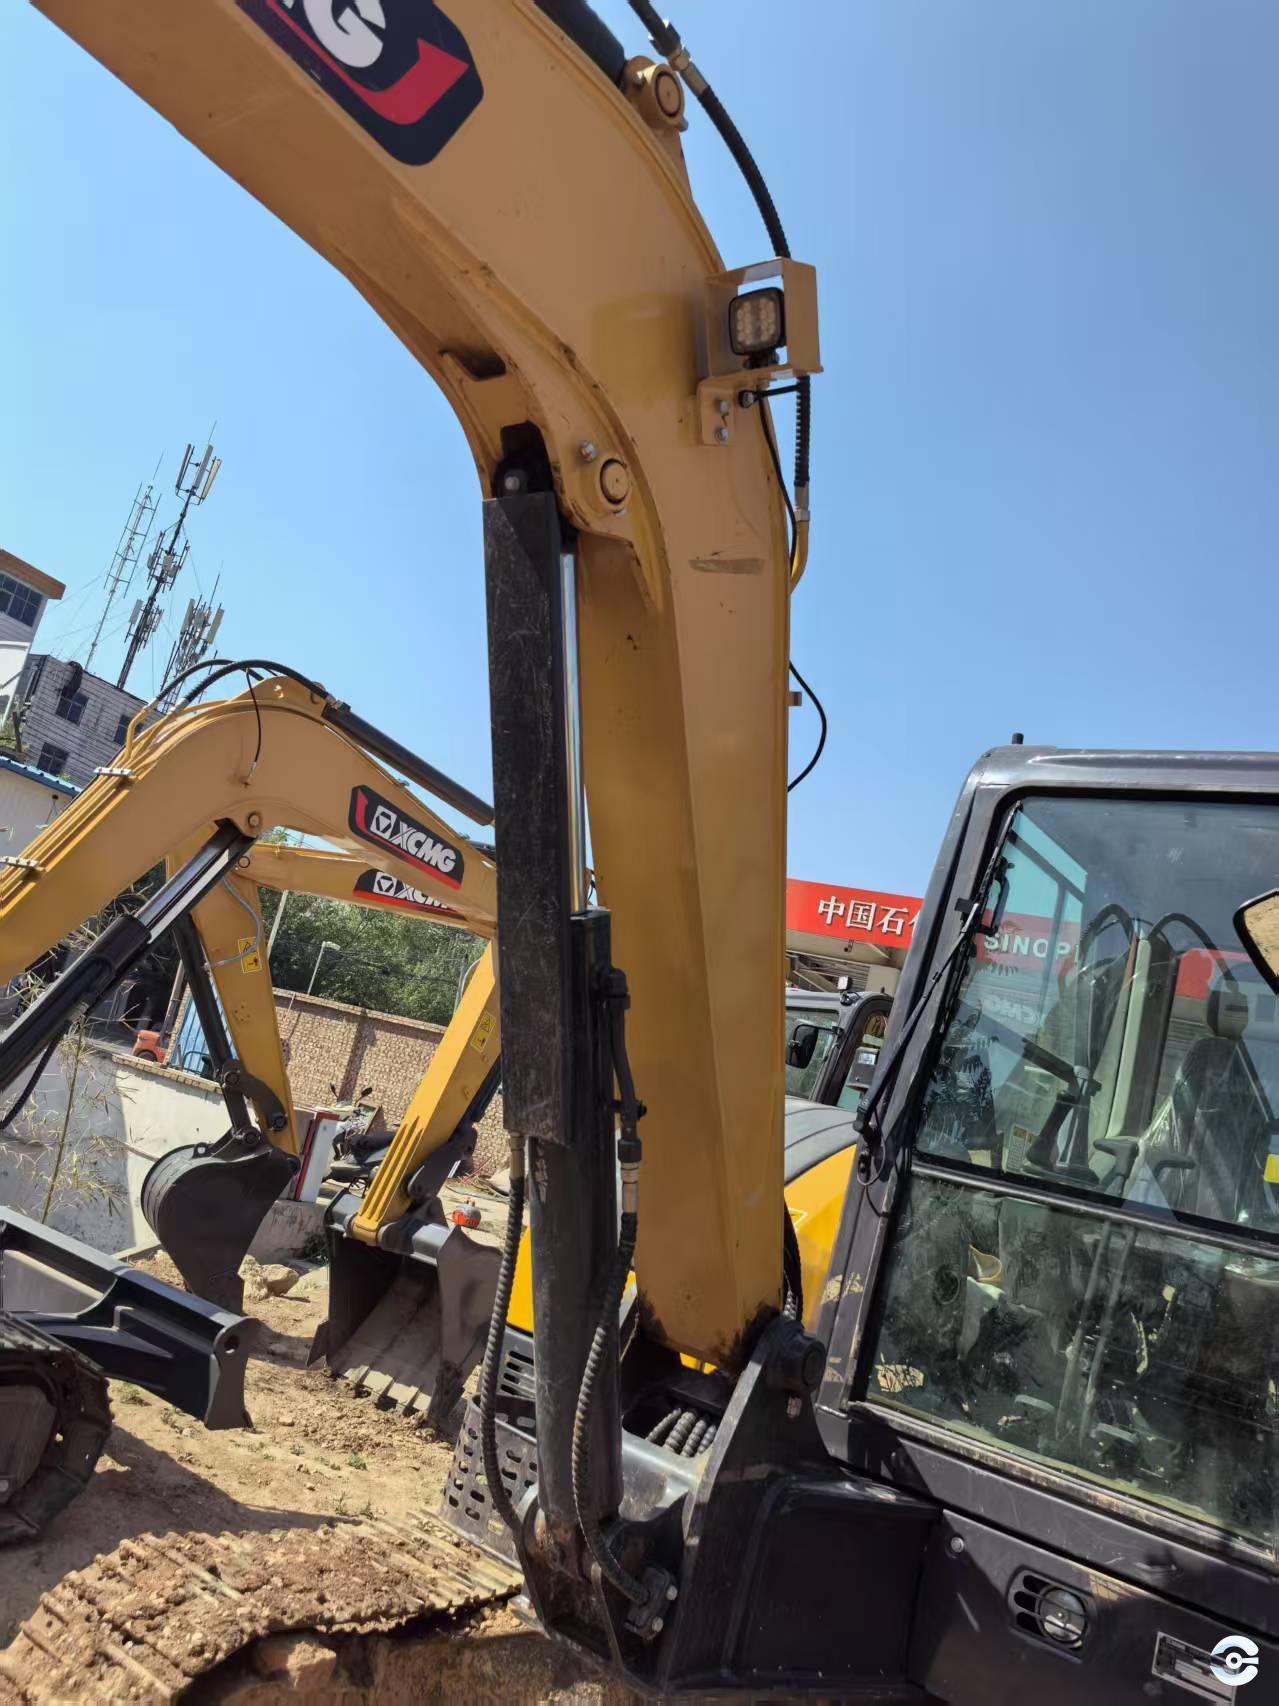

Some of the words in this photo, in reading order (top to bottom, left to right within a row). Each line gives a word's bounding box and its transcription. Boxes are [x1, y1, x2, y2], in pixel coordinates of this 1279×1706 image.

[282, 0, 386, 68] G
[389, 820, 457, 873] XCMG
[983, 933, 1080, 962] SINOP
